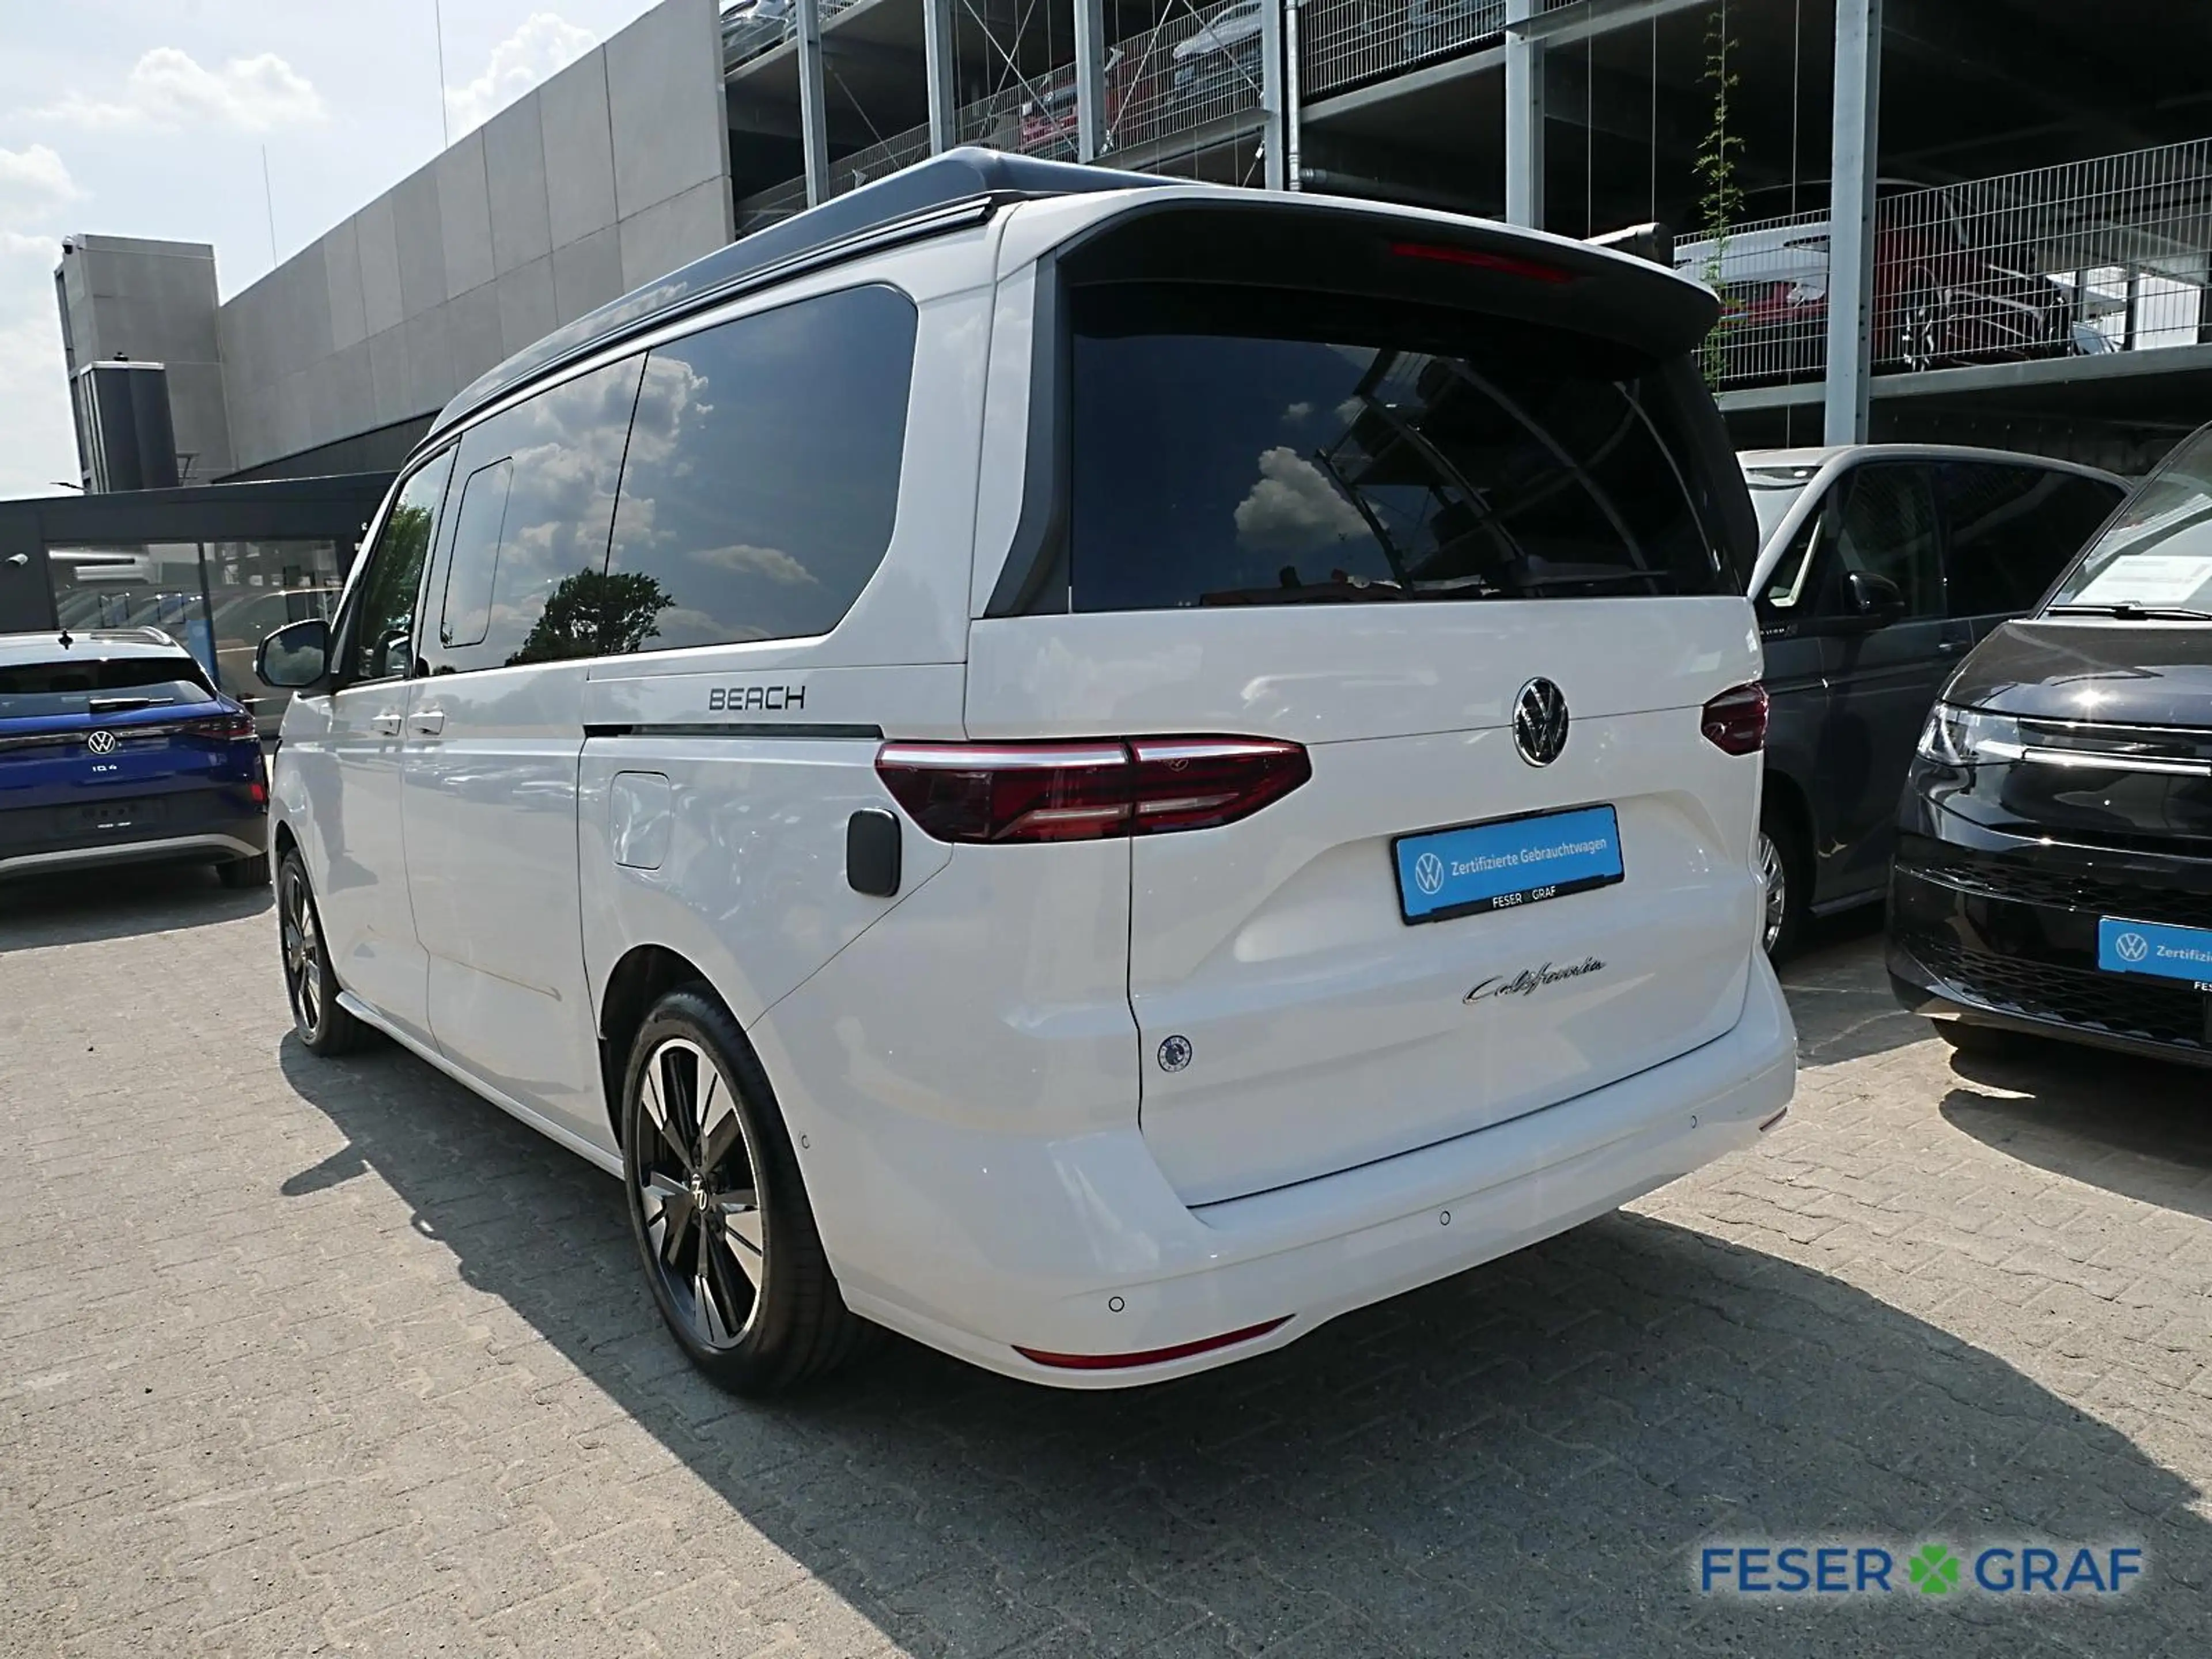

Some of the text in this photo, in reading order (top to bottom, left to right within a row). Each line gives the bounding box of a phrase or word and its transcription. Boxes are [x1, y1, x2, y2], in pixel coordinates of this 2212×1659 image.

[709, 685, 805, 710] BEACH
[88, 730, 115, 755] VW
[1450, 838, 1607, 876] Zertifizierte Gebrauchtwagen
[1415, 853, 1444, 895] VW
[1493, 886, 1556, 908] FESER GRAF
[2115, 933, 2148, 962] VW
[2156, 945, 2212, 963] Zertifizi
[1463, 956, 1607, 1005] California
